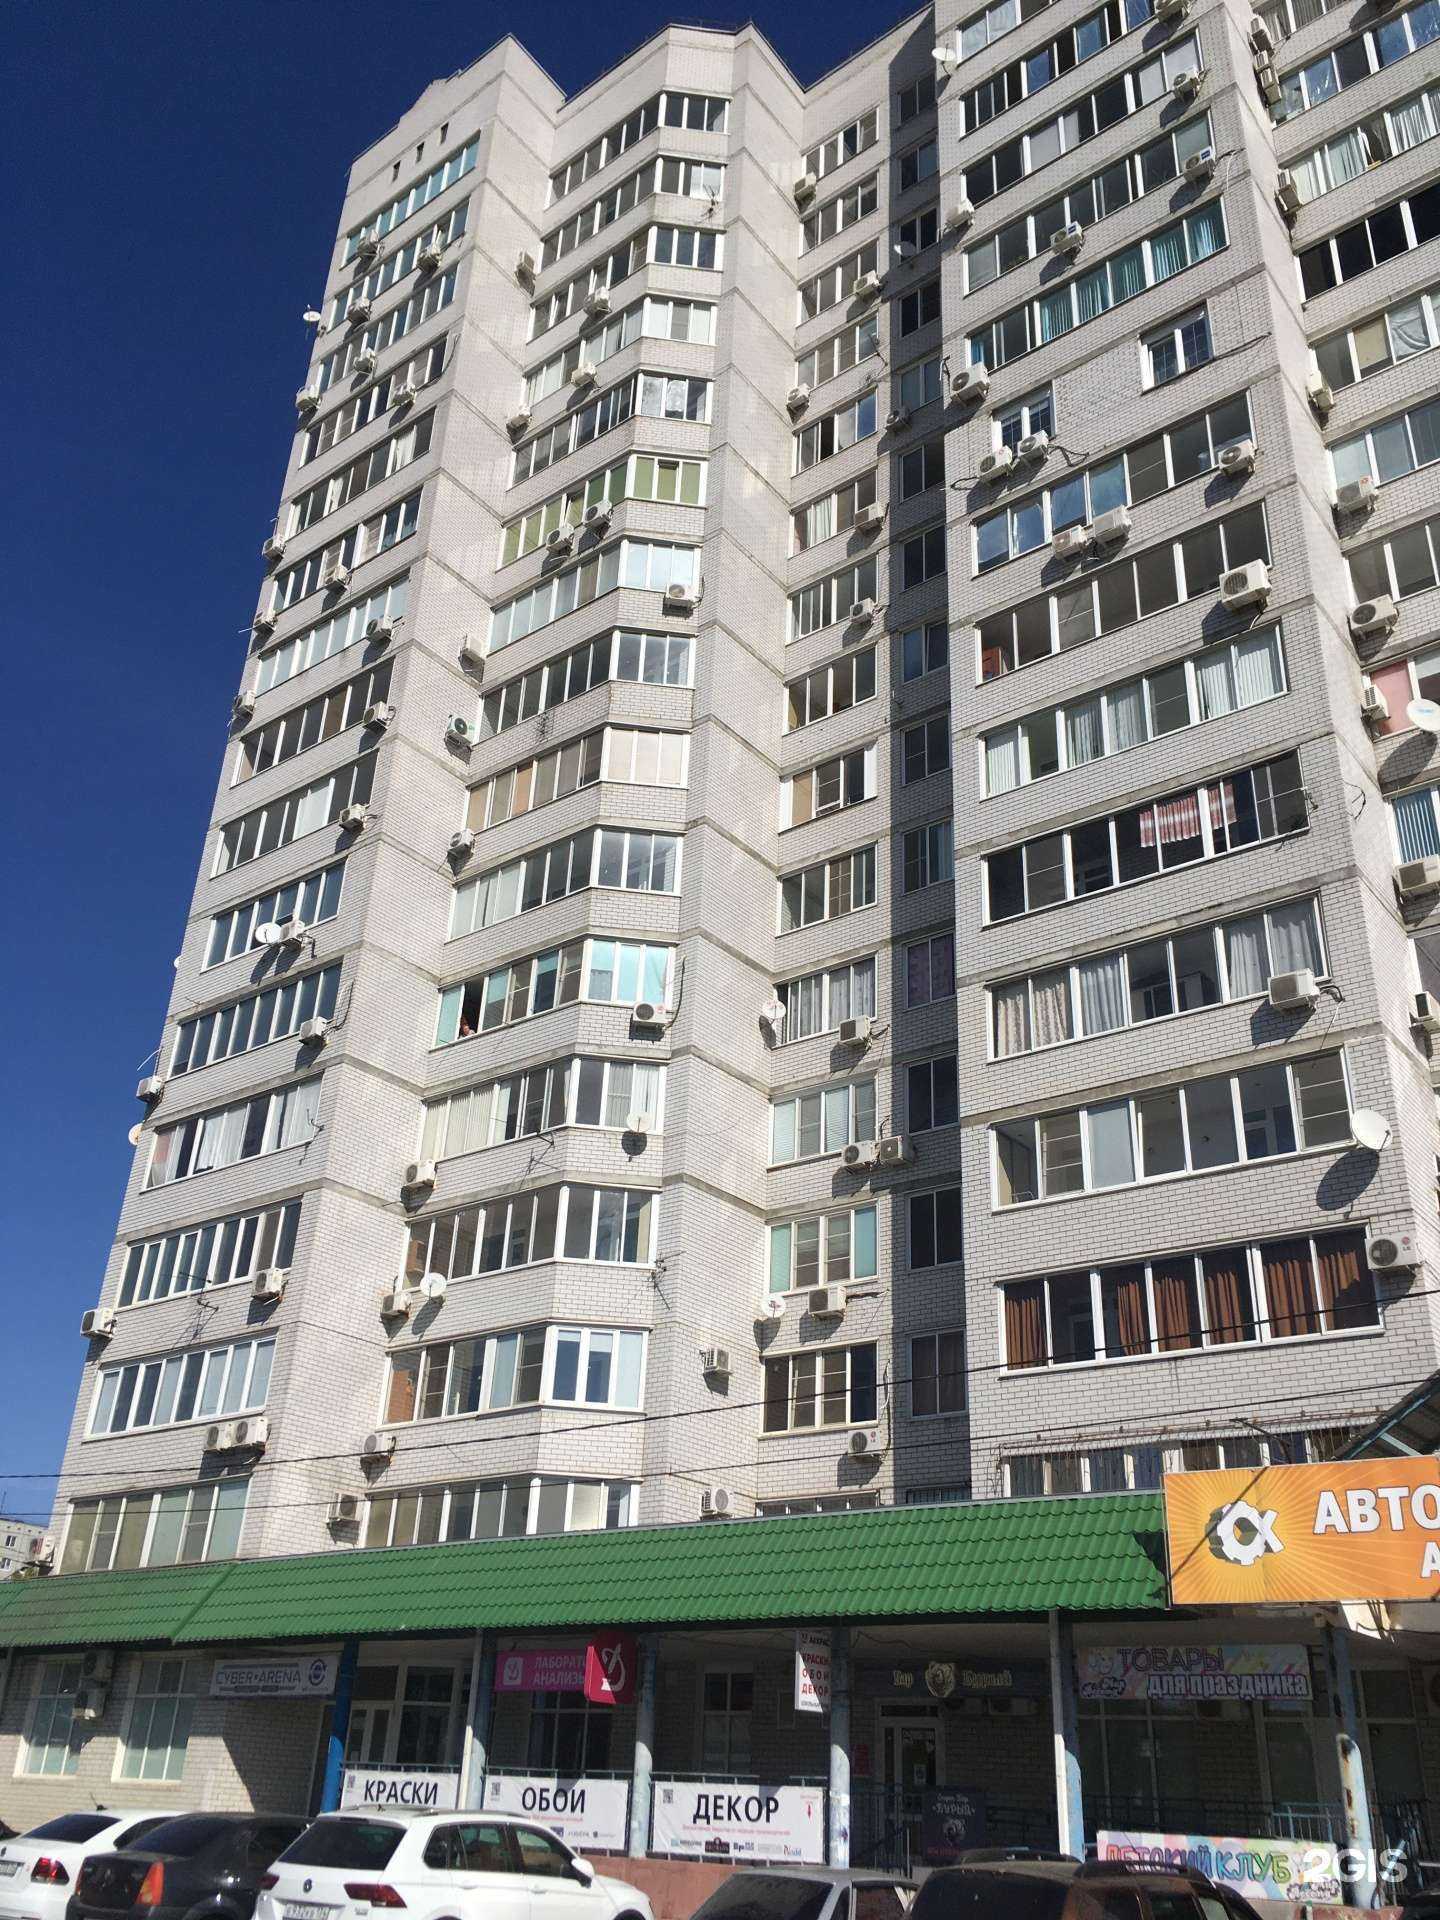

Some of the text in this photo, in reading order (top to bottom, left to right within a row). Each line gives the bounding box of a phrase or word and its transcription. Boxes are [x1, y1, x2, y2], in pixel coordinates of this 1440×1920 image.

[1313, 1483, 1440, 1535] АВТО
[534, 1655, 585, 1669] ЛАБОРАТ
[1119, 1647, 1225, 1673] ТОВАРЫ
[216, 1669, 301, 1685] CYBER ARENA
[1147, 1674, 1186, 1698] для
[1188, 1674, 1309, 1701] праздника
[364, 1779, 439, 1805] КРАСКИ
[521, 1787, 586, 1814] ОБОИ
[692, 1793, 780, 1825] ДЕКОР
[1214, 1850, 1292, 1884] КЛУБ
